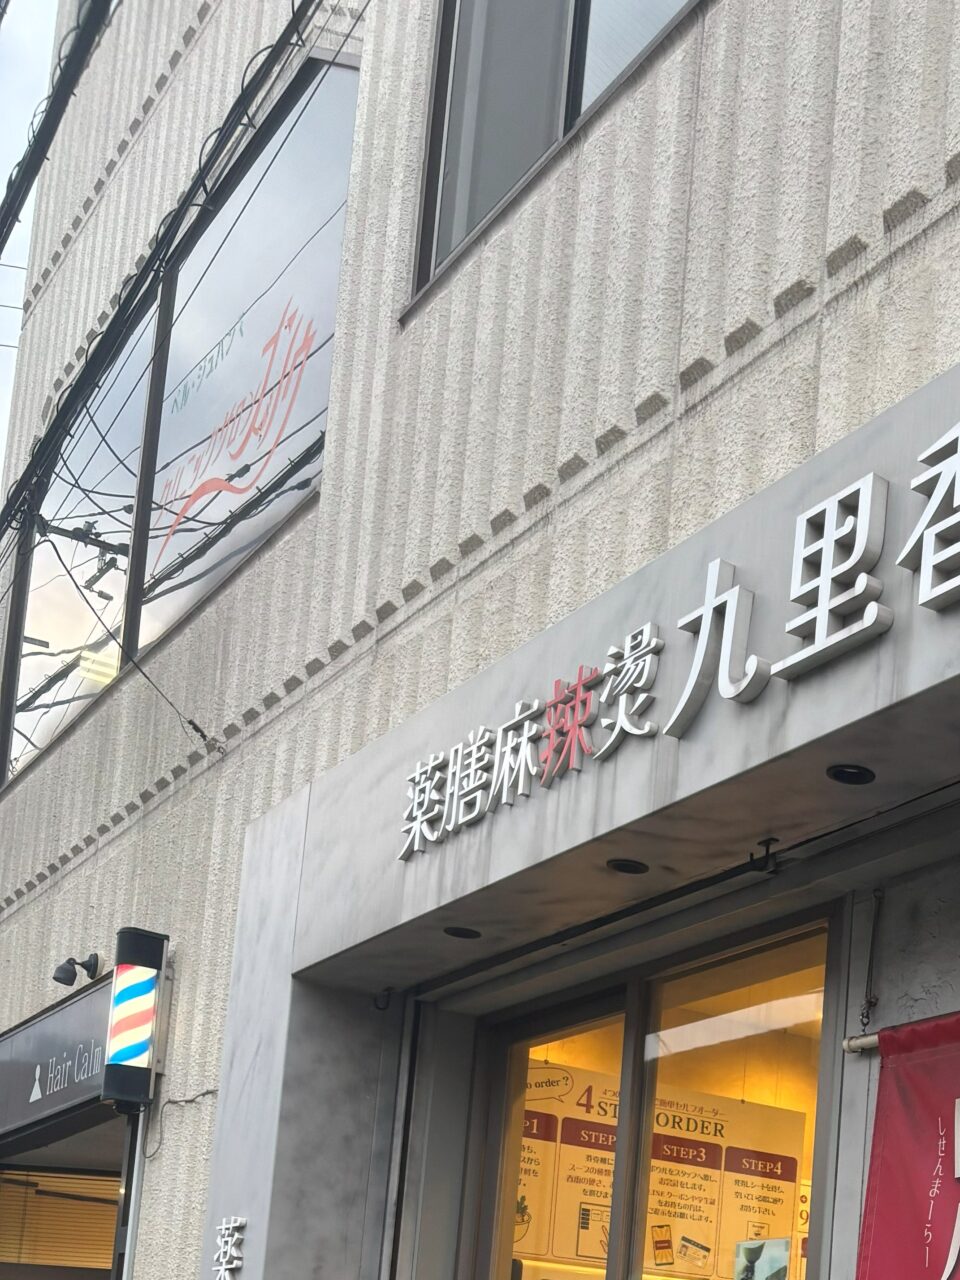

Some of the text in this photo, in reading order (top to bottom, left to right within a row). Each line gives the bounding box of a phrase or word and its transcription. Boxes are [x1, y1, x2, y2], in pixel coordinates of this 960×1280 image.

[46, 1039, 102, 1095] Hair Calm
[534, 1079, 561, 1089] order
[575, 1085, 726, 1138] 4 ST ORDER
[580, 1129, 617, 1146] STEP
[662, 1143, 707, 1162] STEP3
[741, 1157, 783, 1176] STEP4
[923, 1117, 947, 1268] しせんまーらー
